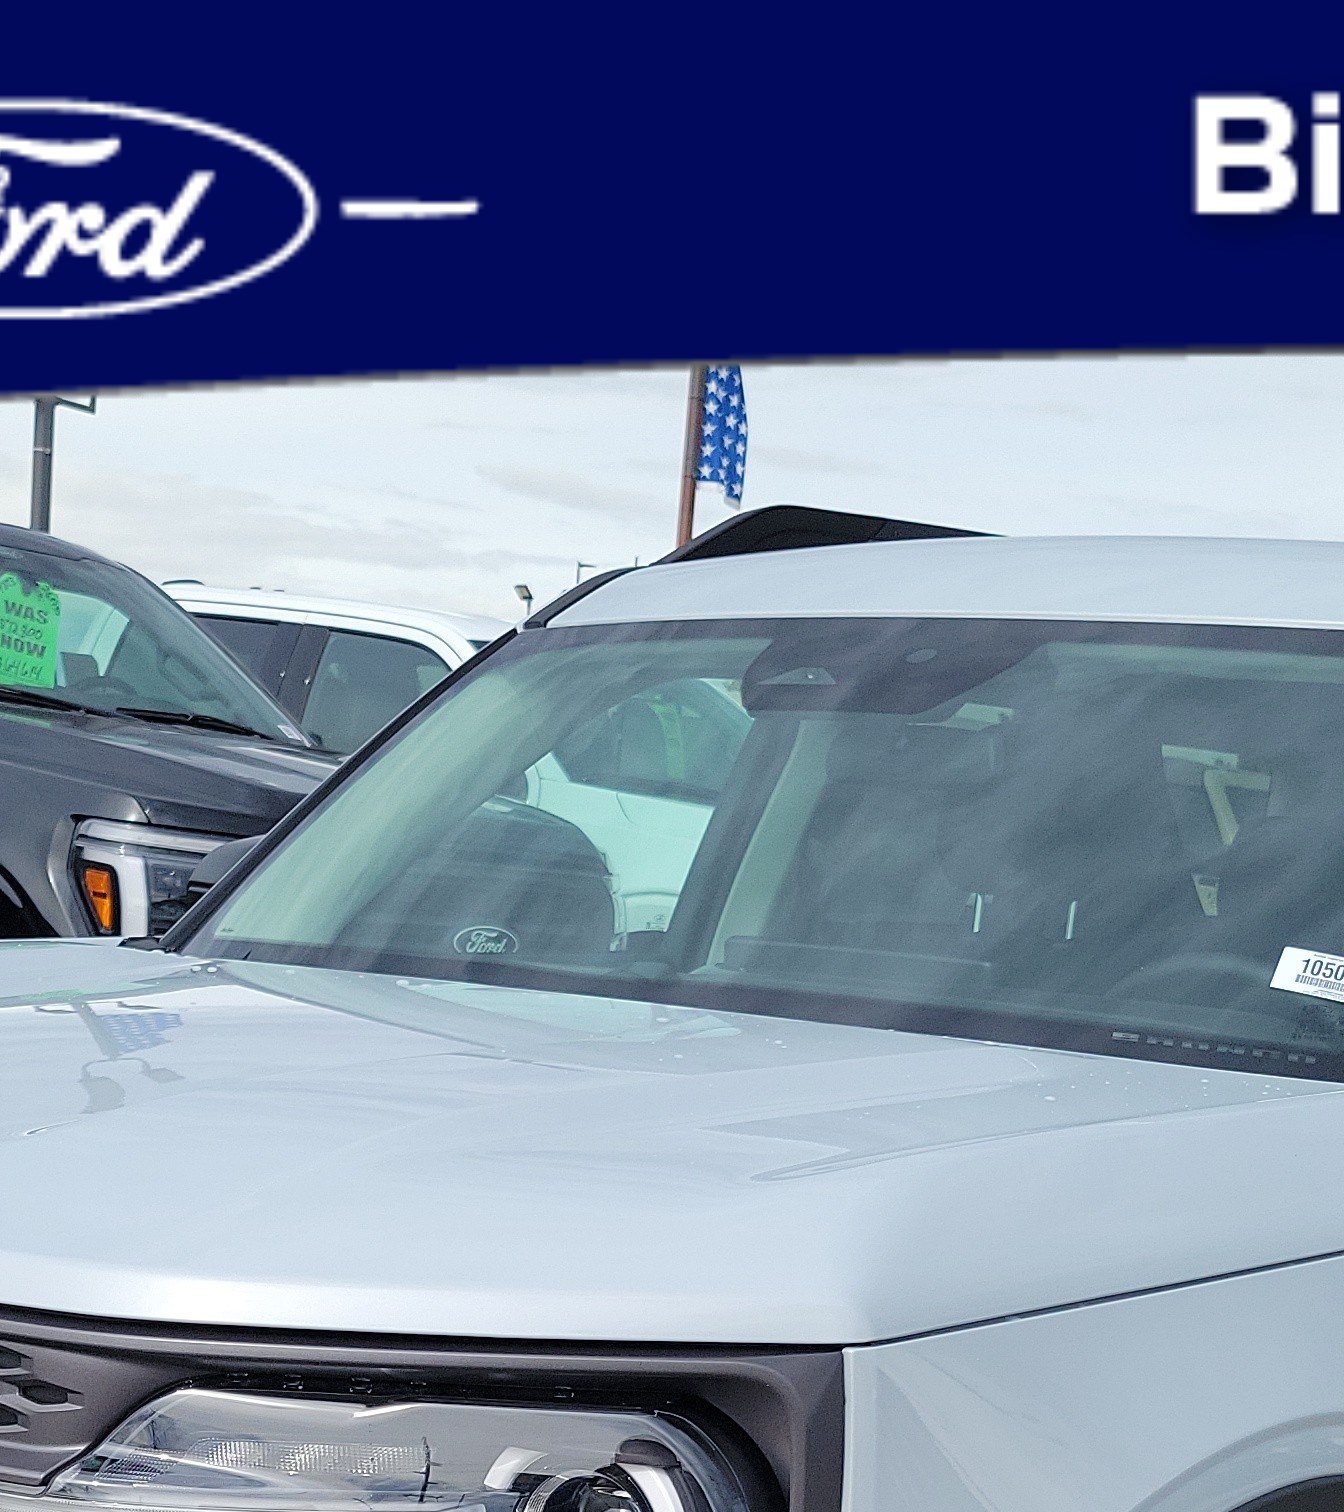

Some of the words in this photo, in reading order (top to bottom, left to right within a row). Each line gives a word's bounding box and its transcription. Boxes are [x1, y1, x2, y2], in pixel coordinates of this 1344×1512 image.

[3, 599, 49, 625] WAS
[0, 633, 47, 658] NOW
[466, 930, 509, 954] Ford
